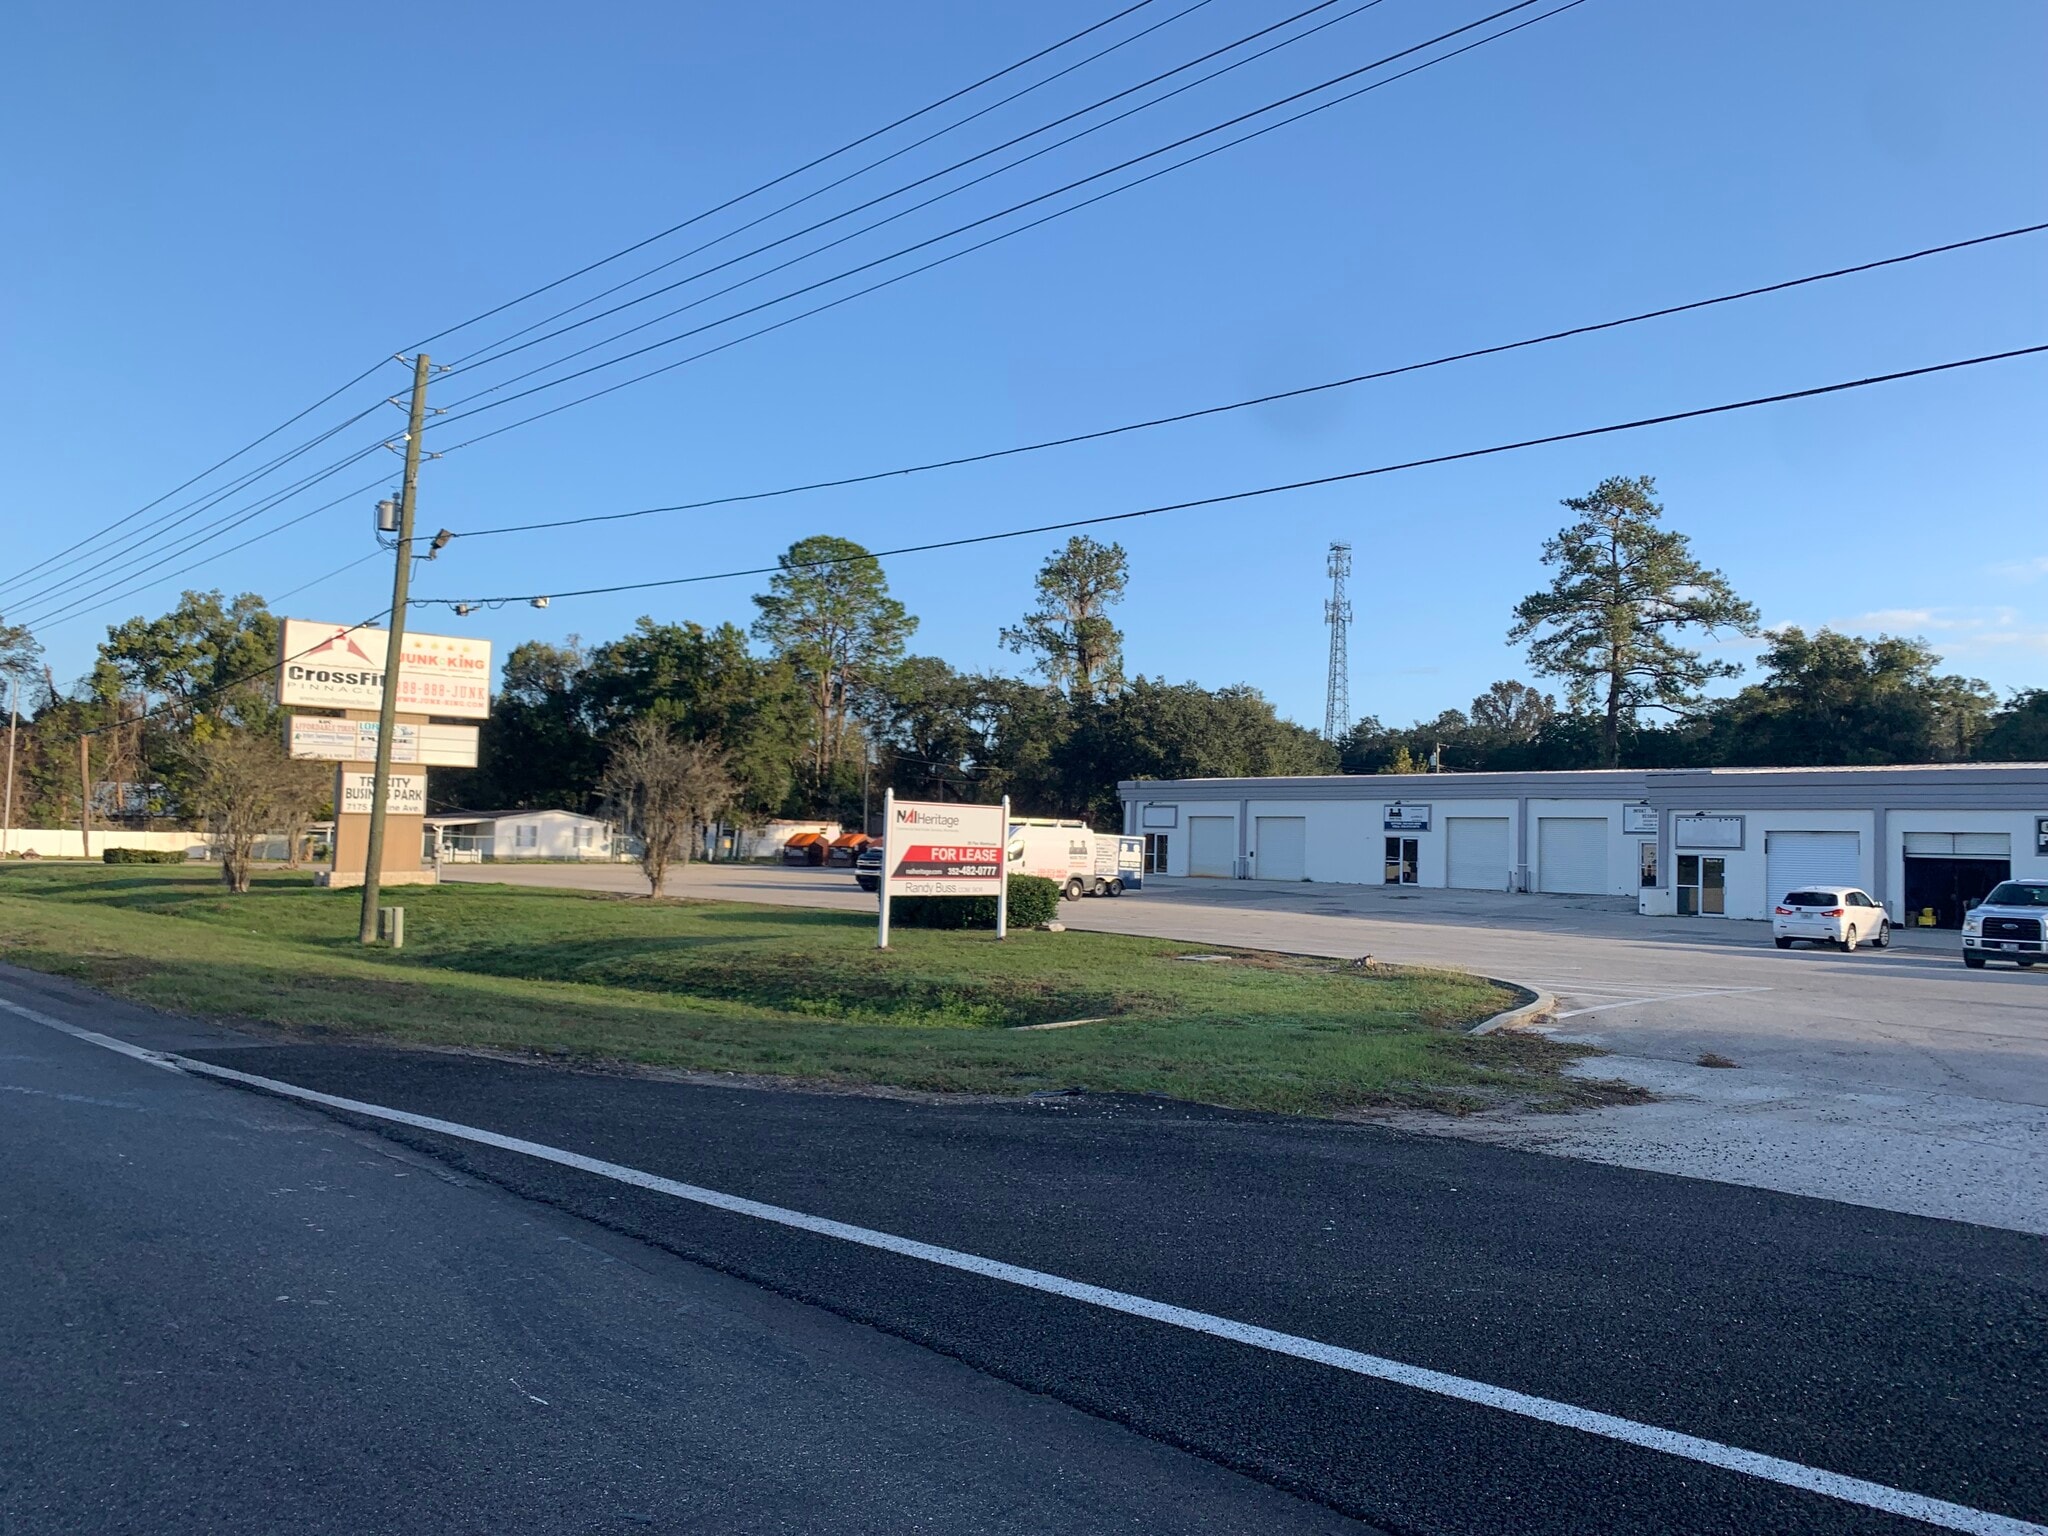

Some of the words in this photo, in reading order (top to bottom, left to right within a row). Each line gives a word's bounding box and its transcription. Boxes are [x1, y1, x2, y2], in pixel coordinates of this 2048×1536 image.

[400, 653, 438, 666] JUNK
[346, 787, 391, 801] BUSINS
[394, 789, 423, 801] PARK
[931, 847, 957, 861] FOR
[959, 848, 997, 862] LEASE
[905, 882, 933, 896] Randy
[935, 882, 957, 893] Buss
